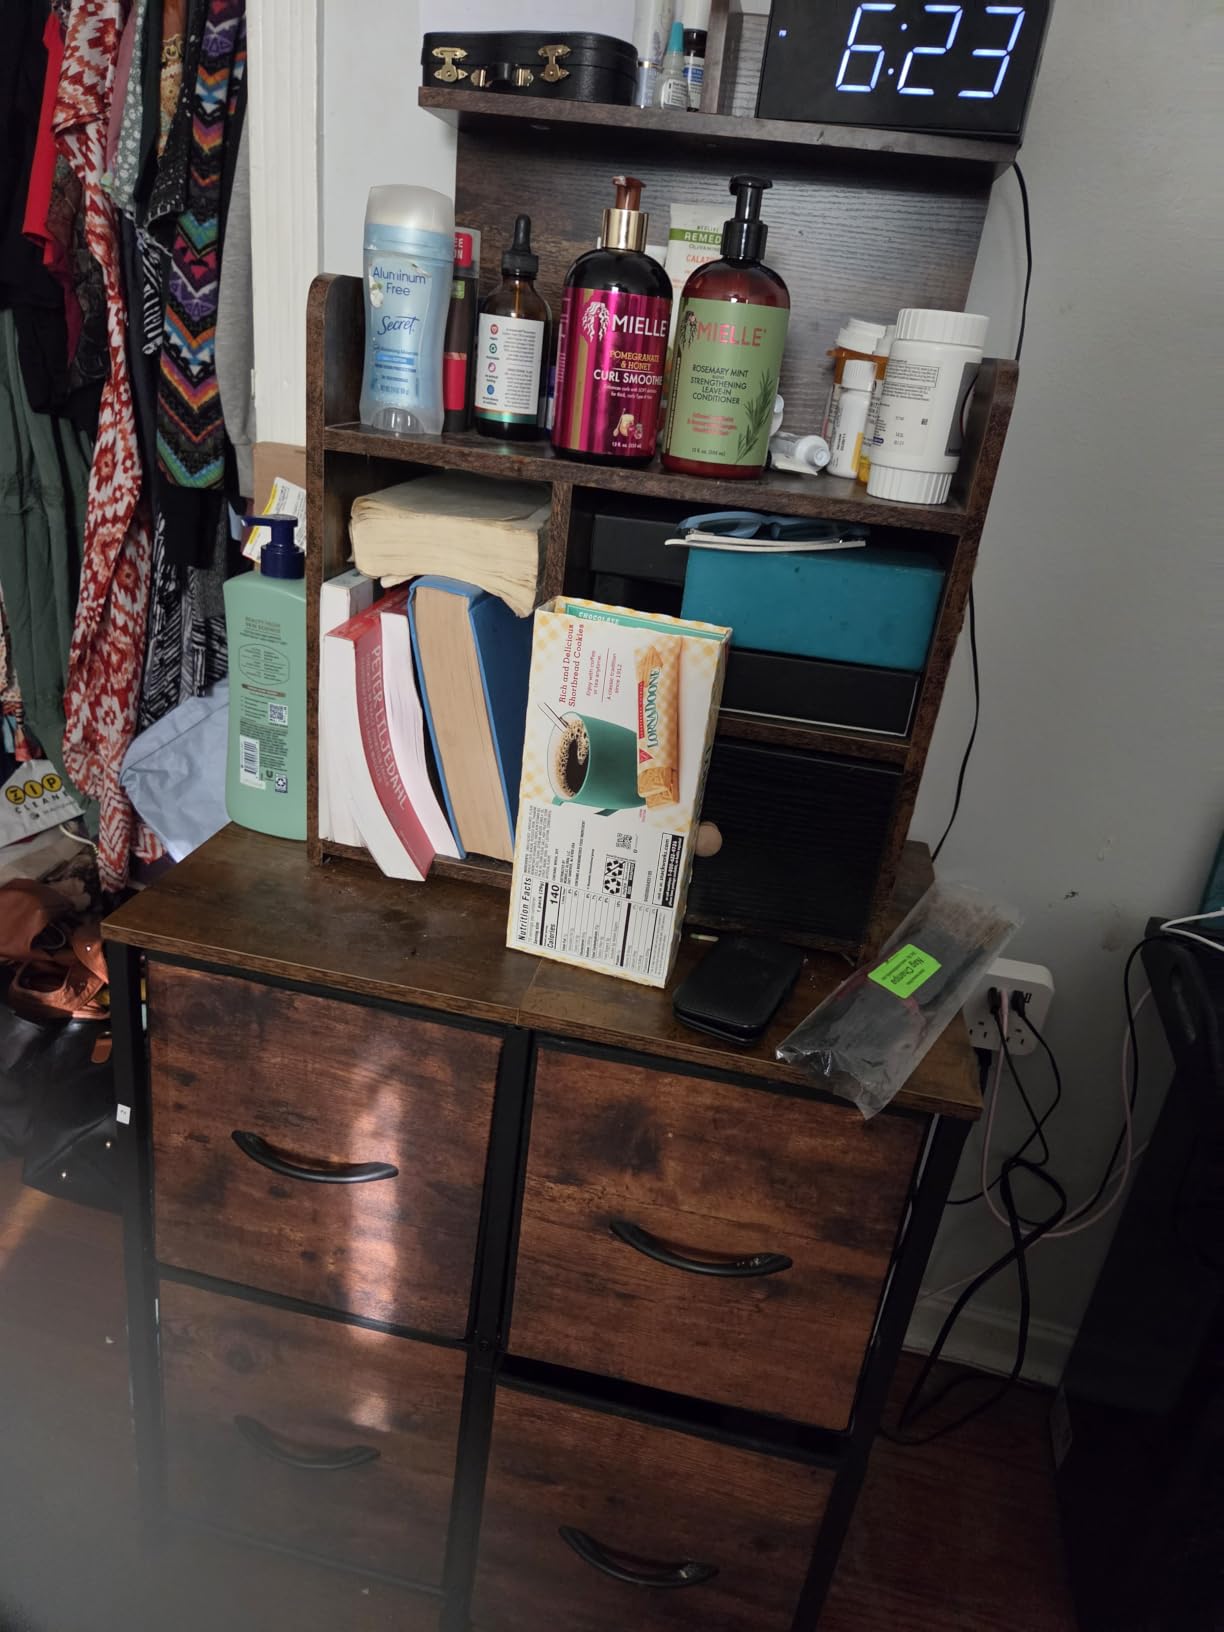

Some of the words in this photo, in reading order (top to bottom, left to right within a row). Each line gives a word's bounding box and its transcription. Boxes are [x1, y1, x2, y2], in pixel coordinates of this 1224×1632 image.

[835, 3, 1026, 98] 6:23
[684, 231, 722, 244] REMED
[372, 266, 426, 285] Aluminum
[386, 282, 411, 296] Free
[377, 315, 420, 336] Secret
[611, 314, 667, 337] MIELLE
[696, 321, 763, 347] MIELLE
[593, 369, 620, 383] CURL
[628, 361, 652, 371] HONEY
[692, 364, 729, 376] ROSEMARY
[730, 368, 749, 378] MINT
[690, 377, 747, 389] STRENGTHENING
[702, 386, 732, 396] LEAVE-IN
[692, 392, 740, 405] CONDITIONER
[563, 624, 574, 663] Delicious
[573, 624, 585, 659] Cookies
[372, 645, 384, 708] PETER
[562, 665, 570, 680] and
[568, 661, 580, 707] Shortbread
[559, 682, 568, 704] Rich
[645, 668, 660, 711] DOONE
[646, 711, 658, 748] LORNA
[375, 708, 409, 811] LILJEDAHL
[8, 776, 58, 803] ZIP
[522, 877, 532, 901] Facts
[550, 884, 560, 905] 140
[518, 893, 529, 941] Nutrition
[547, 923, 555, 949] Calories
